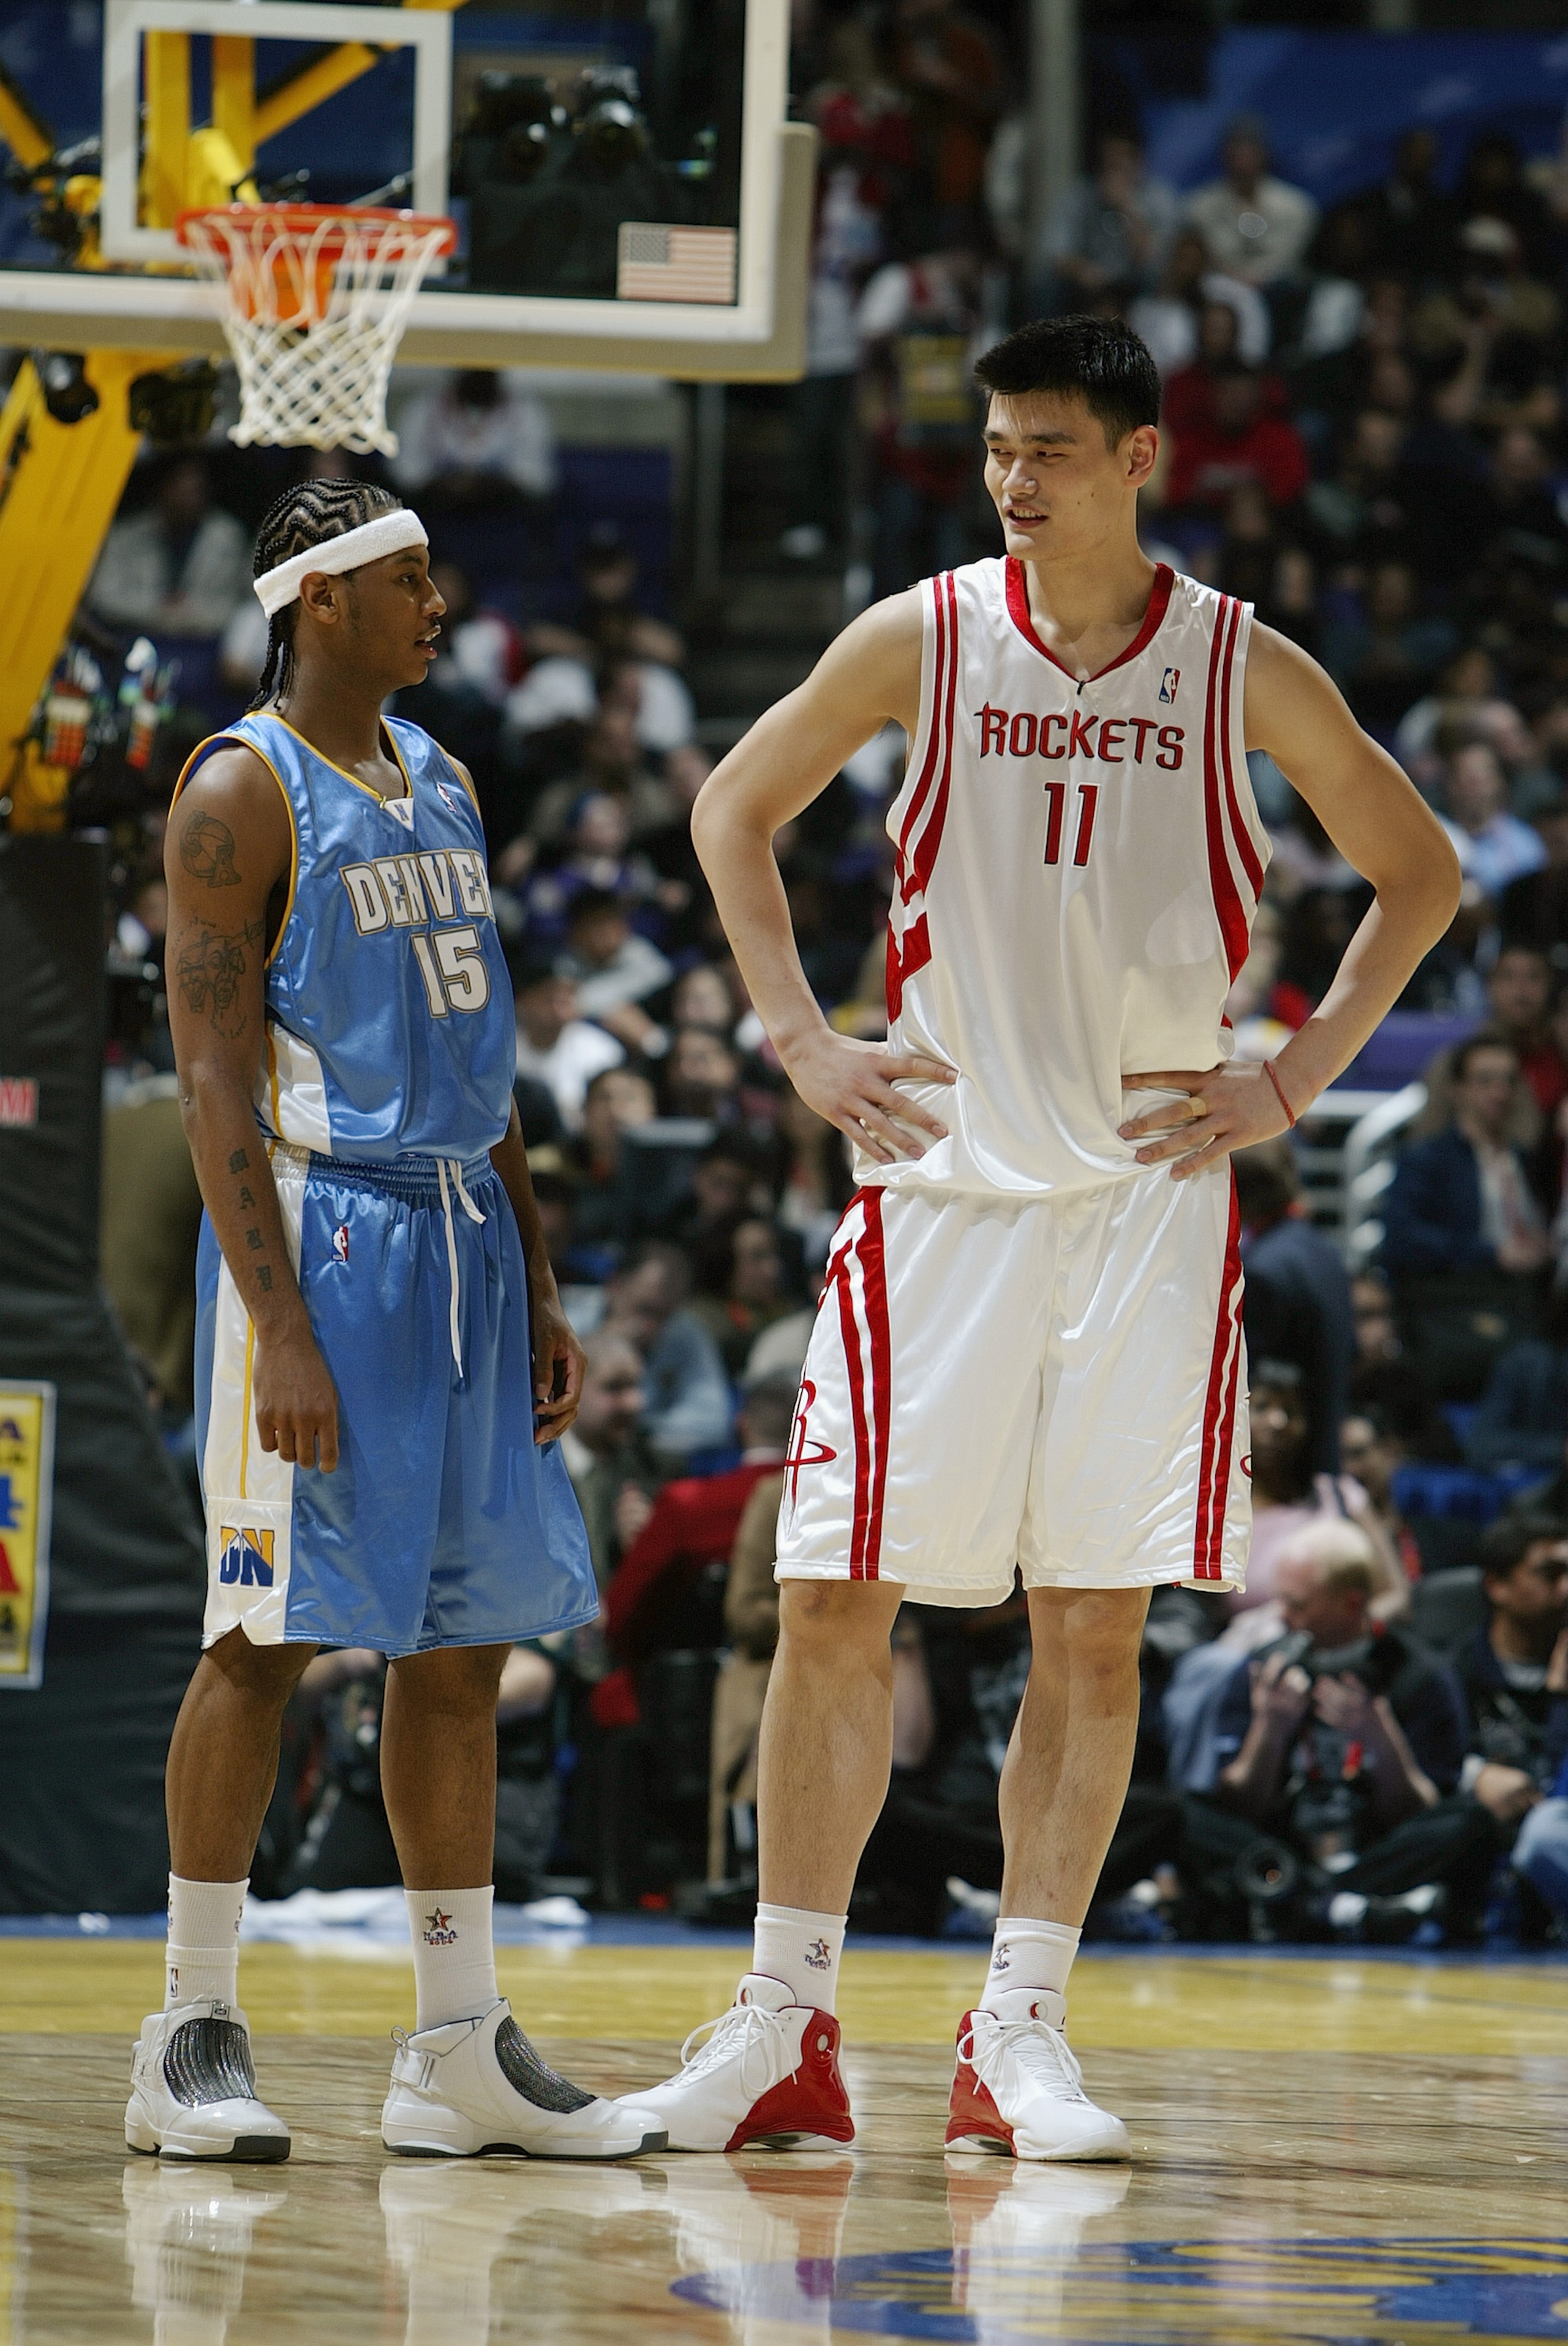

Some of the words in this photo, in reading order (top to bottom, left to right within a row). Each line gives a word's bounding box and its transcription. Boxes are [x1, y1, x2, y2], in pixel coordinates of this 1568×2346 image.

[973, 702, 1185, 770] ROCKETS
[1044, 781, 1099, 868] 11
[411, 925, 490, 1018] 15
